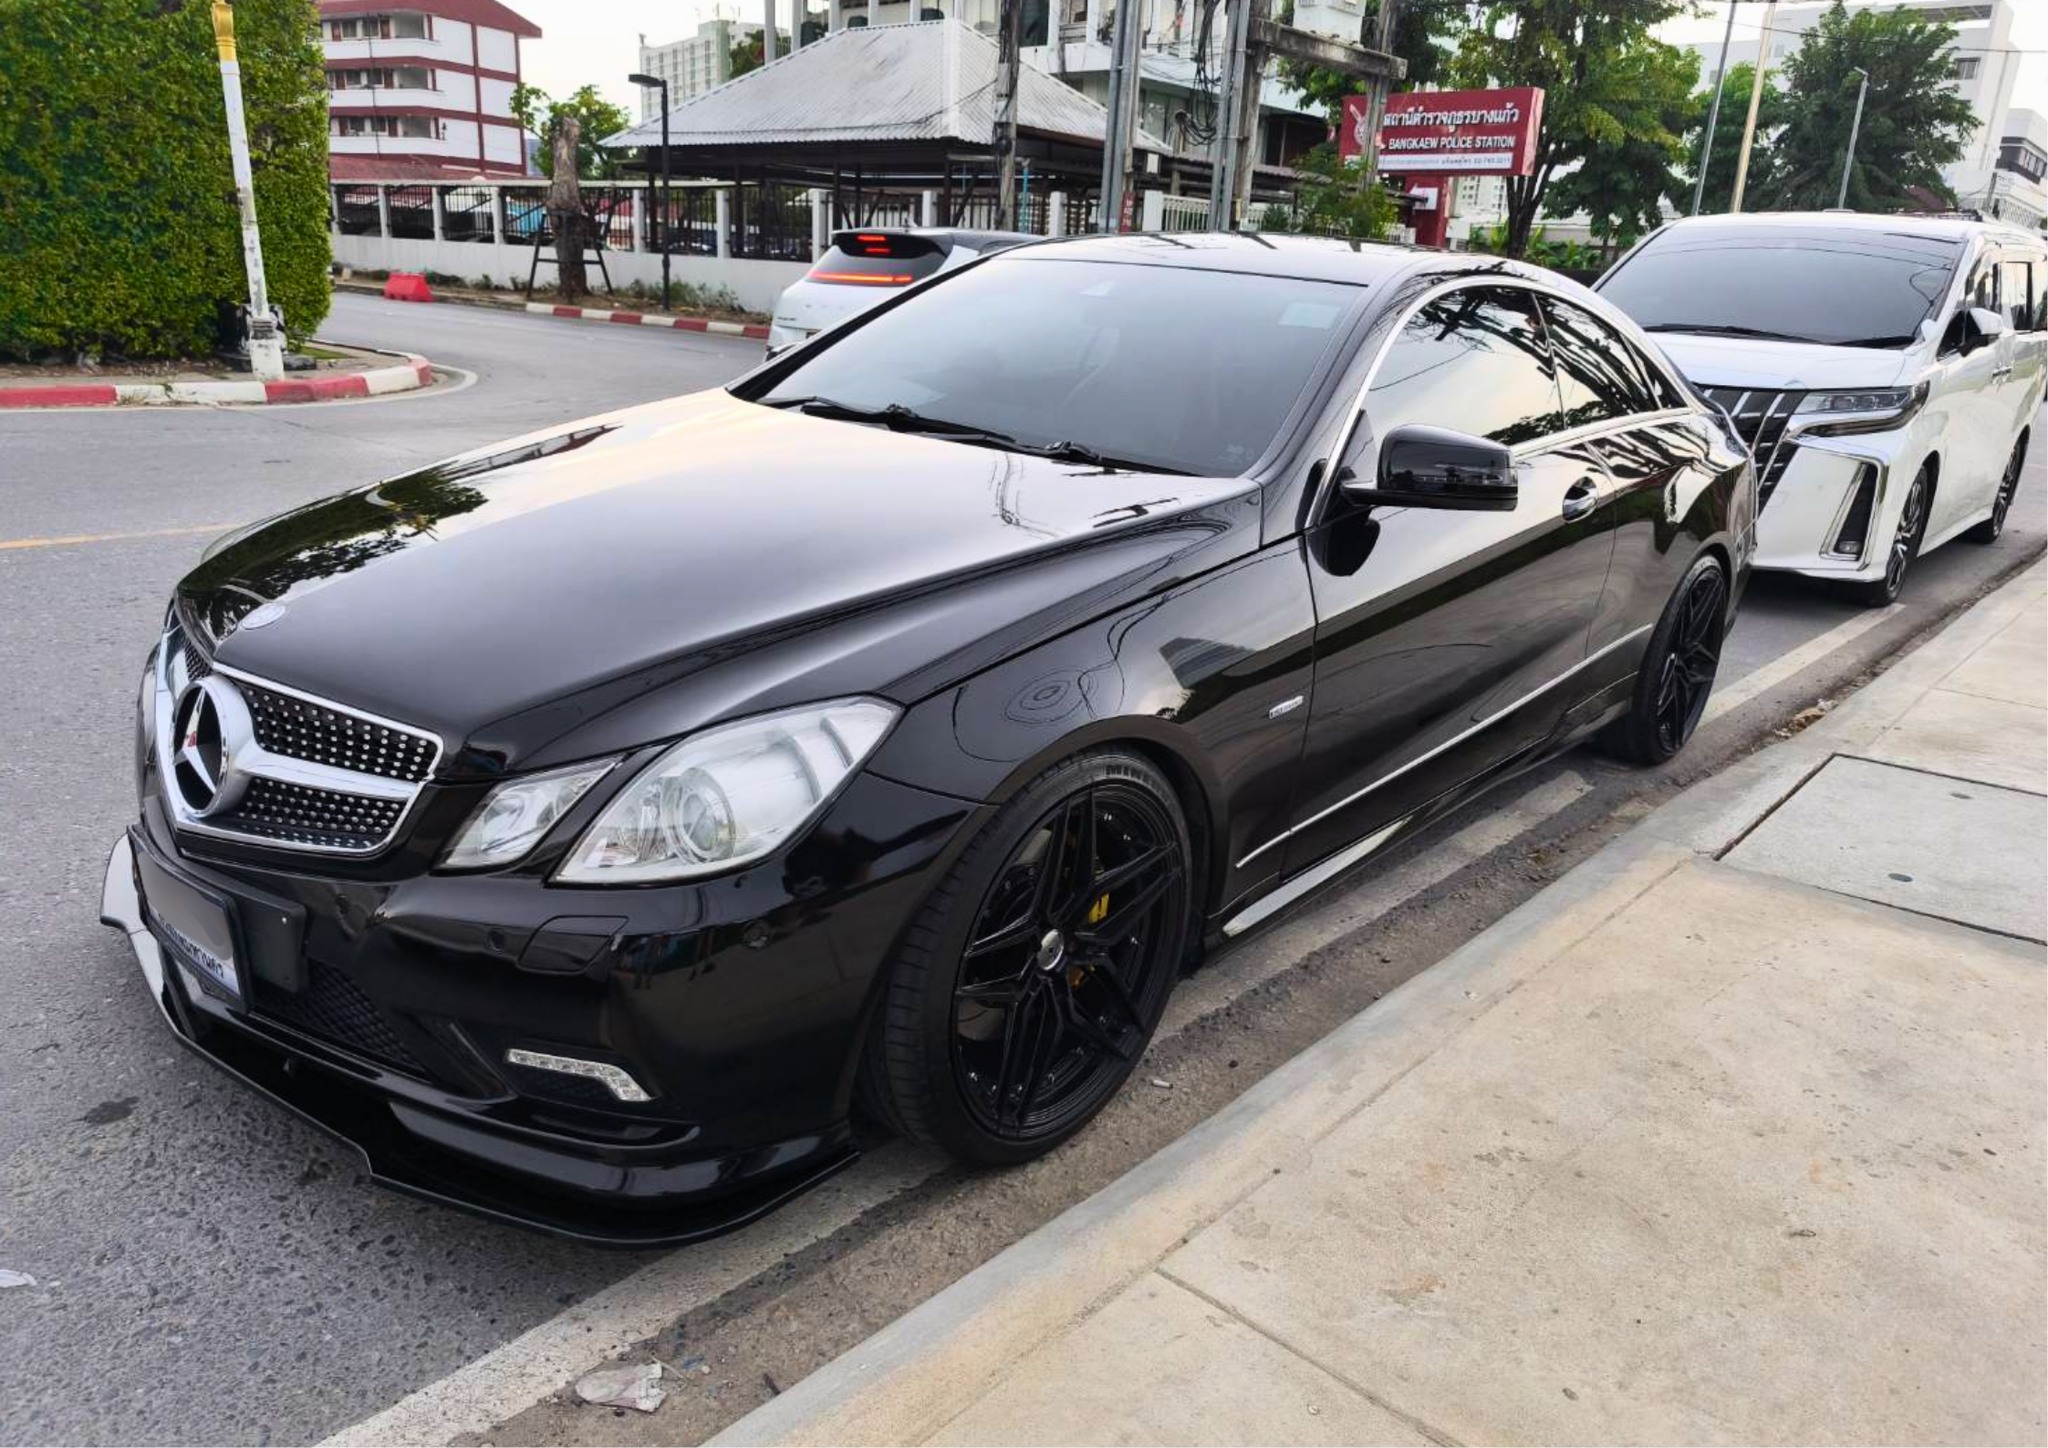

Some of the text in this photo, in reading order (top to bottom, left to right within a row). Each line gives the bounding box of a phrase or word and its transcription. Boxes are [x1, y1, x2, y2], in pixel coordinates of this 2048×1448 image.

[1383, 103, 1519, 133] สถานีตำรวจภูธรบางแก้ว
[1388, 135, 1514, 150] BANGKAEW POLICE STATION
